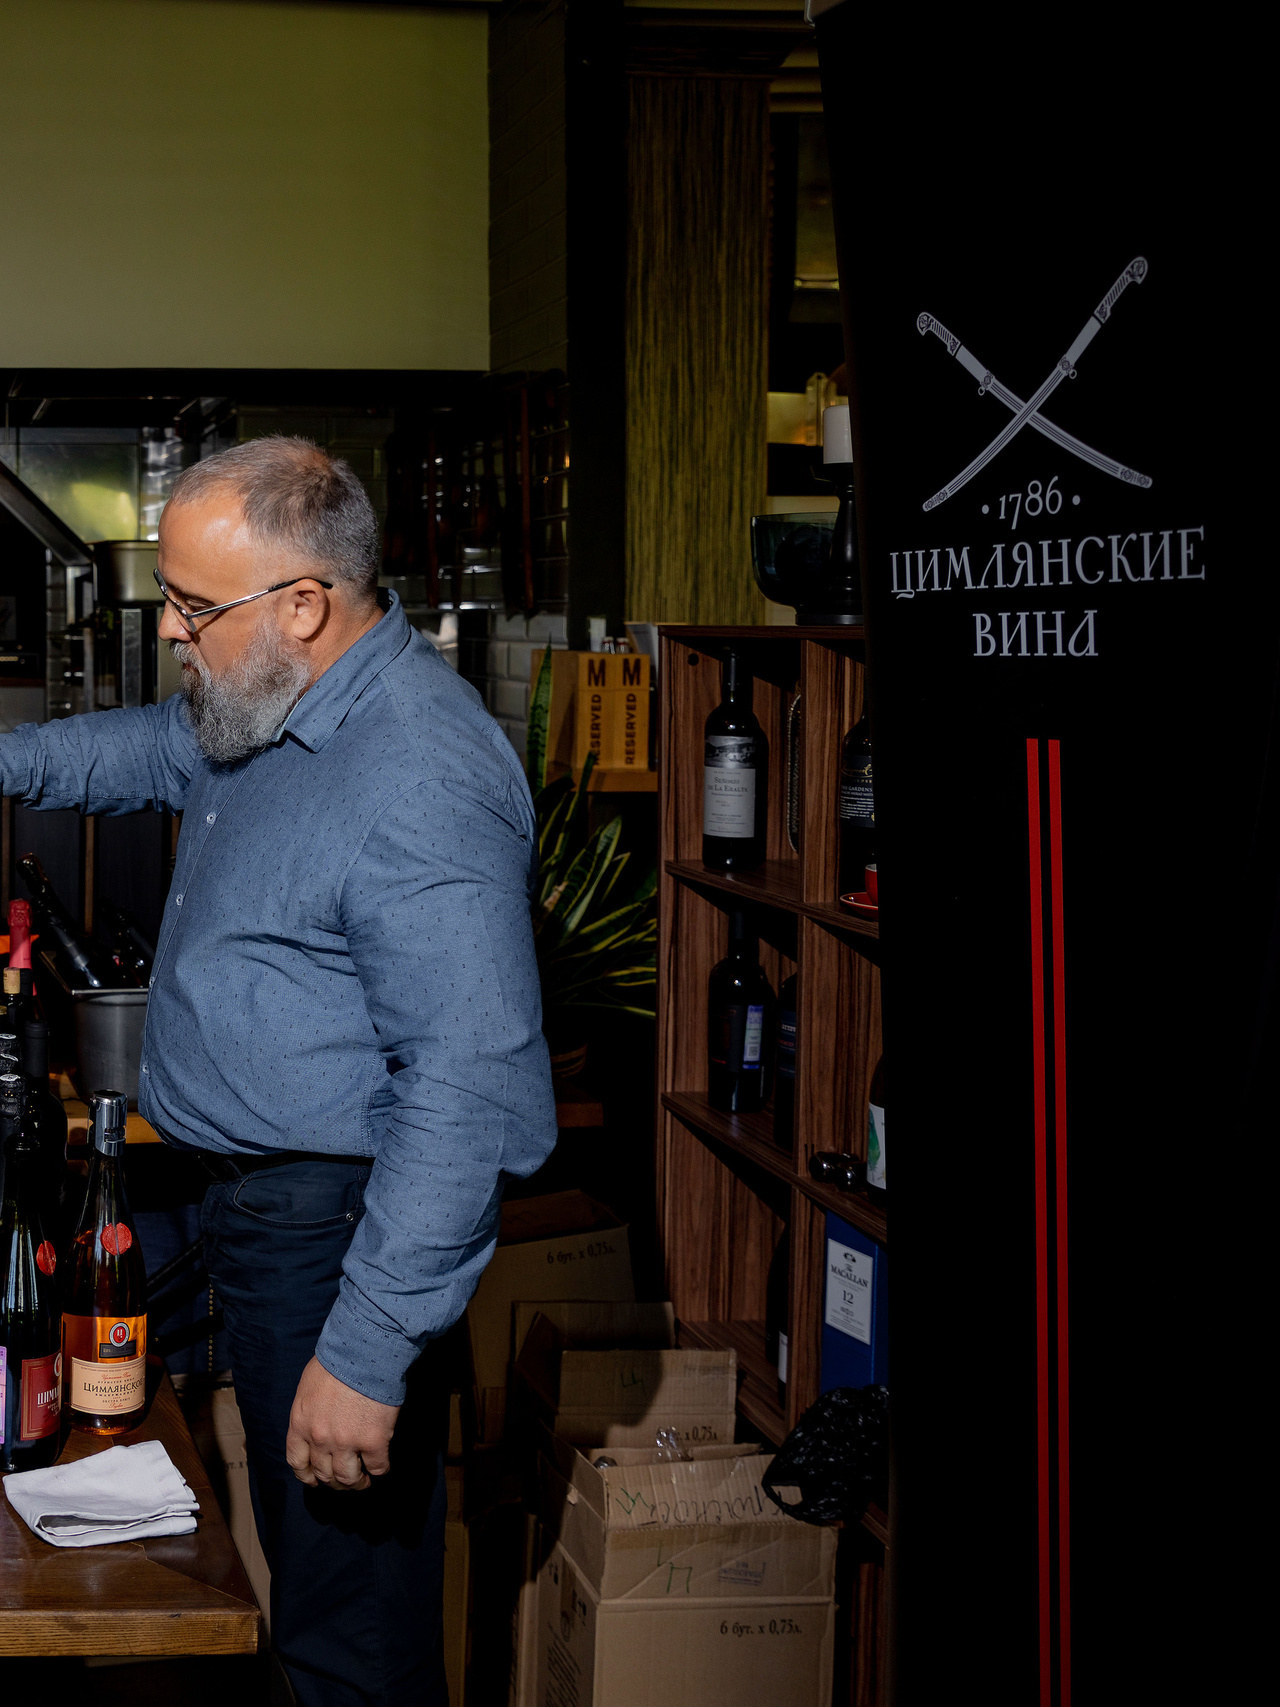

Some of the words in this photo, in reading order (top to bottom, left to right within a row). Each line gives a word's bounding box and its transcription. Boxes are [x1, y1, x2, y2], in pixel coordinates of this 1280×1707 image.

[998, 475, 1064, 531] 1786
[889, 524, 1207, 600] ЦИМЛЯНСКИЕ
[971, 609, 1099, 657] ВИНА
[625, 692, 637, 765] RESERVED
[546, 1251, 554, 1264] 6
[557, 1250, 576, 1264] бут.
[830, 1264, 869, 1288] MACALLAN
[843, 1289, 854, 1305] 12
[720, 1620, 727, 1634] 6
[732, 1620, 755, 1637] бут.
[769, 1619, 803, 1635] 0,75л.
